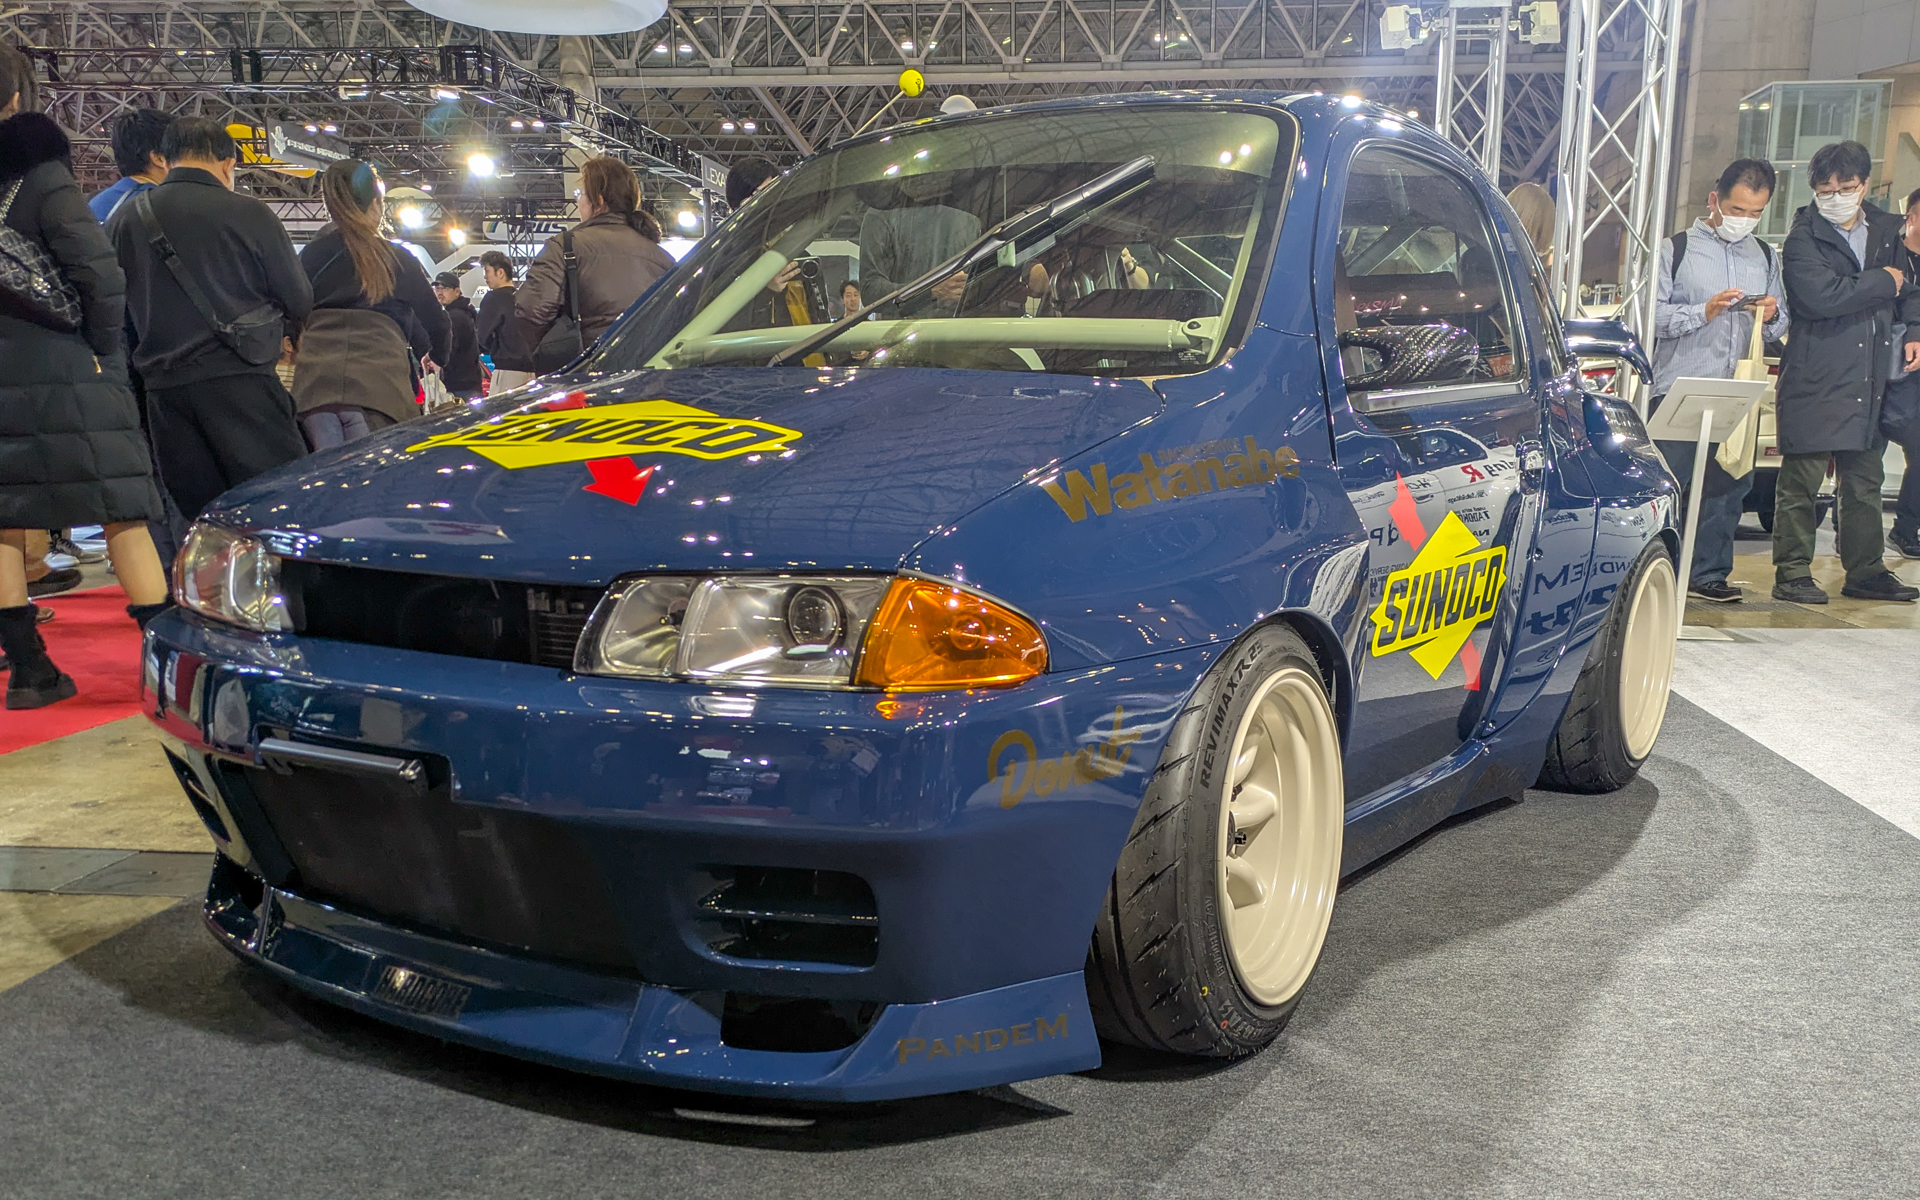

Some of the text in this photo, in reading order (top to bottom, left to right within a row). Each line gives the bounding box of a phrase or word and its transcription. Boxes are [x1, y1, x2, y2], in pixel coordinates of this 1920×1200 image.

[704, 164, 728, 187] LEXA
[1041, 434, 1301, 523] Watanabe
[1376, 552, 1504, 649] SUNOCO
[1199, 675, 1240, 789] REVIMAX
[898, 1013, 1069, 1065] PANDEM
